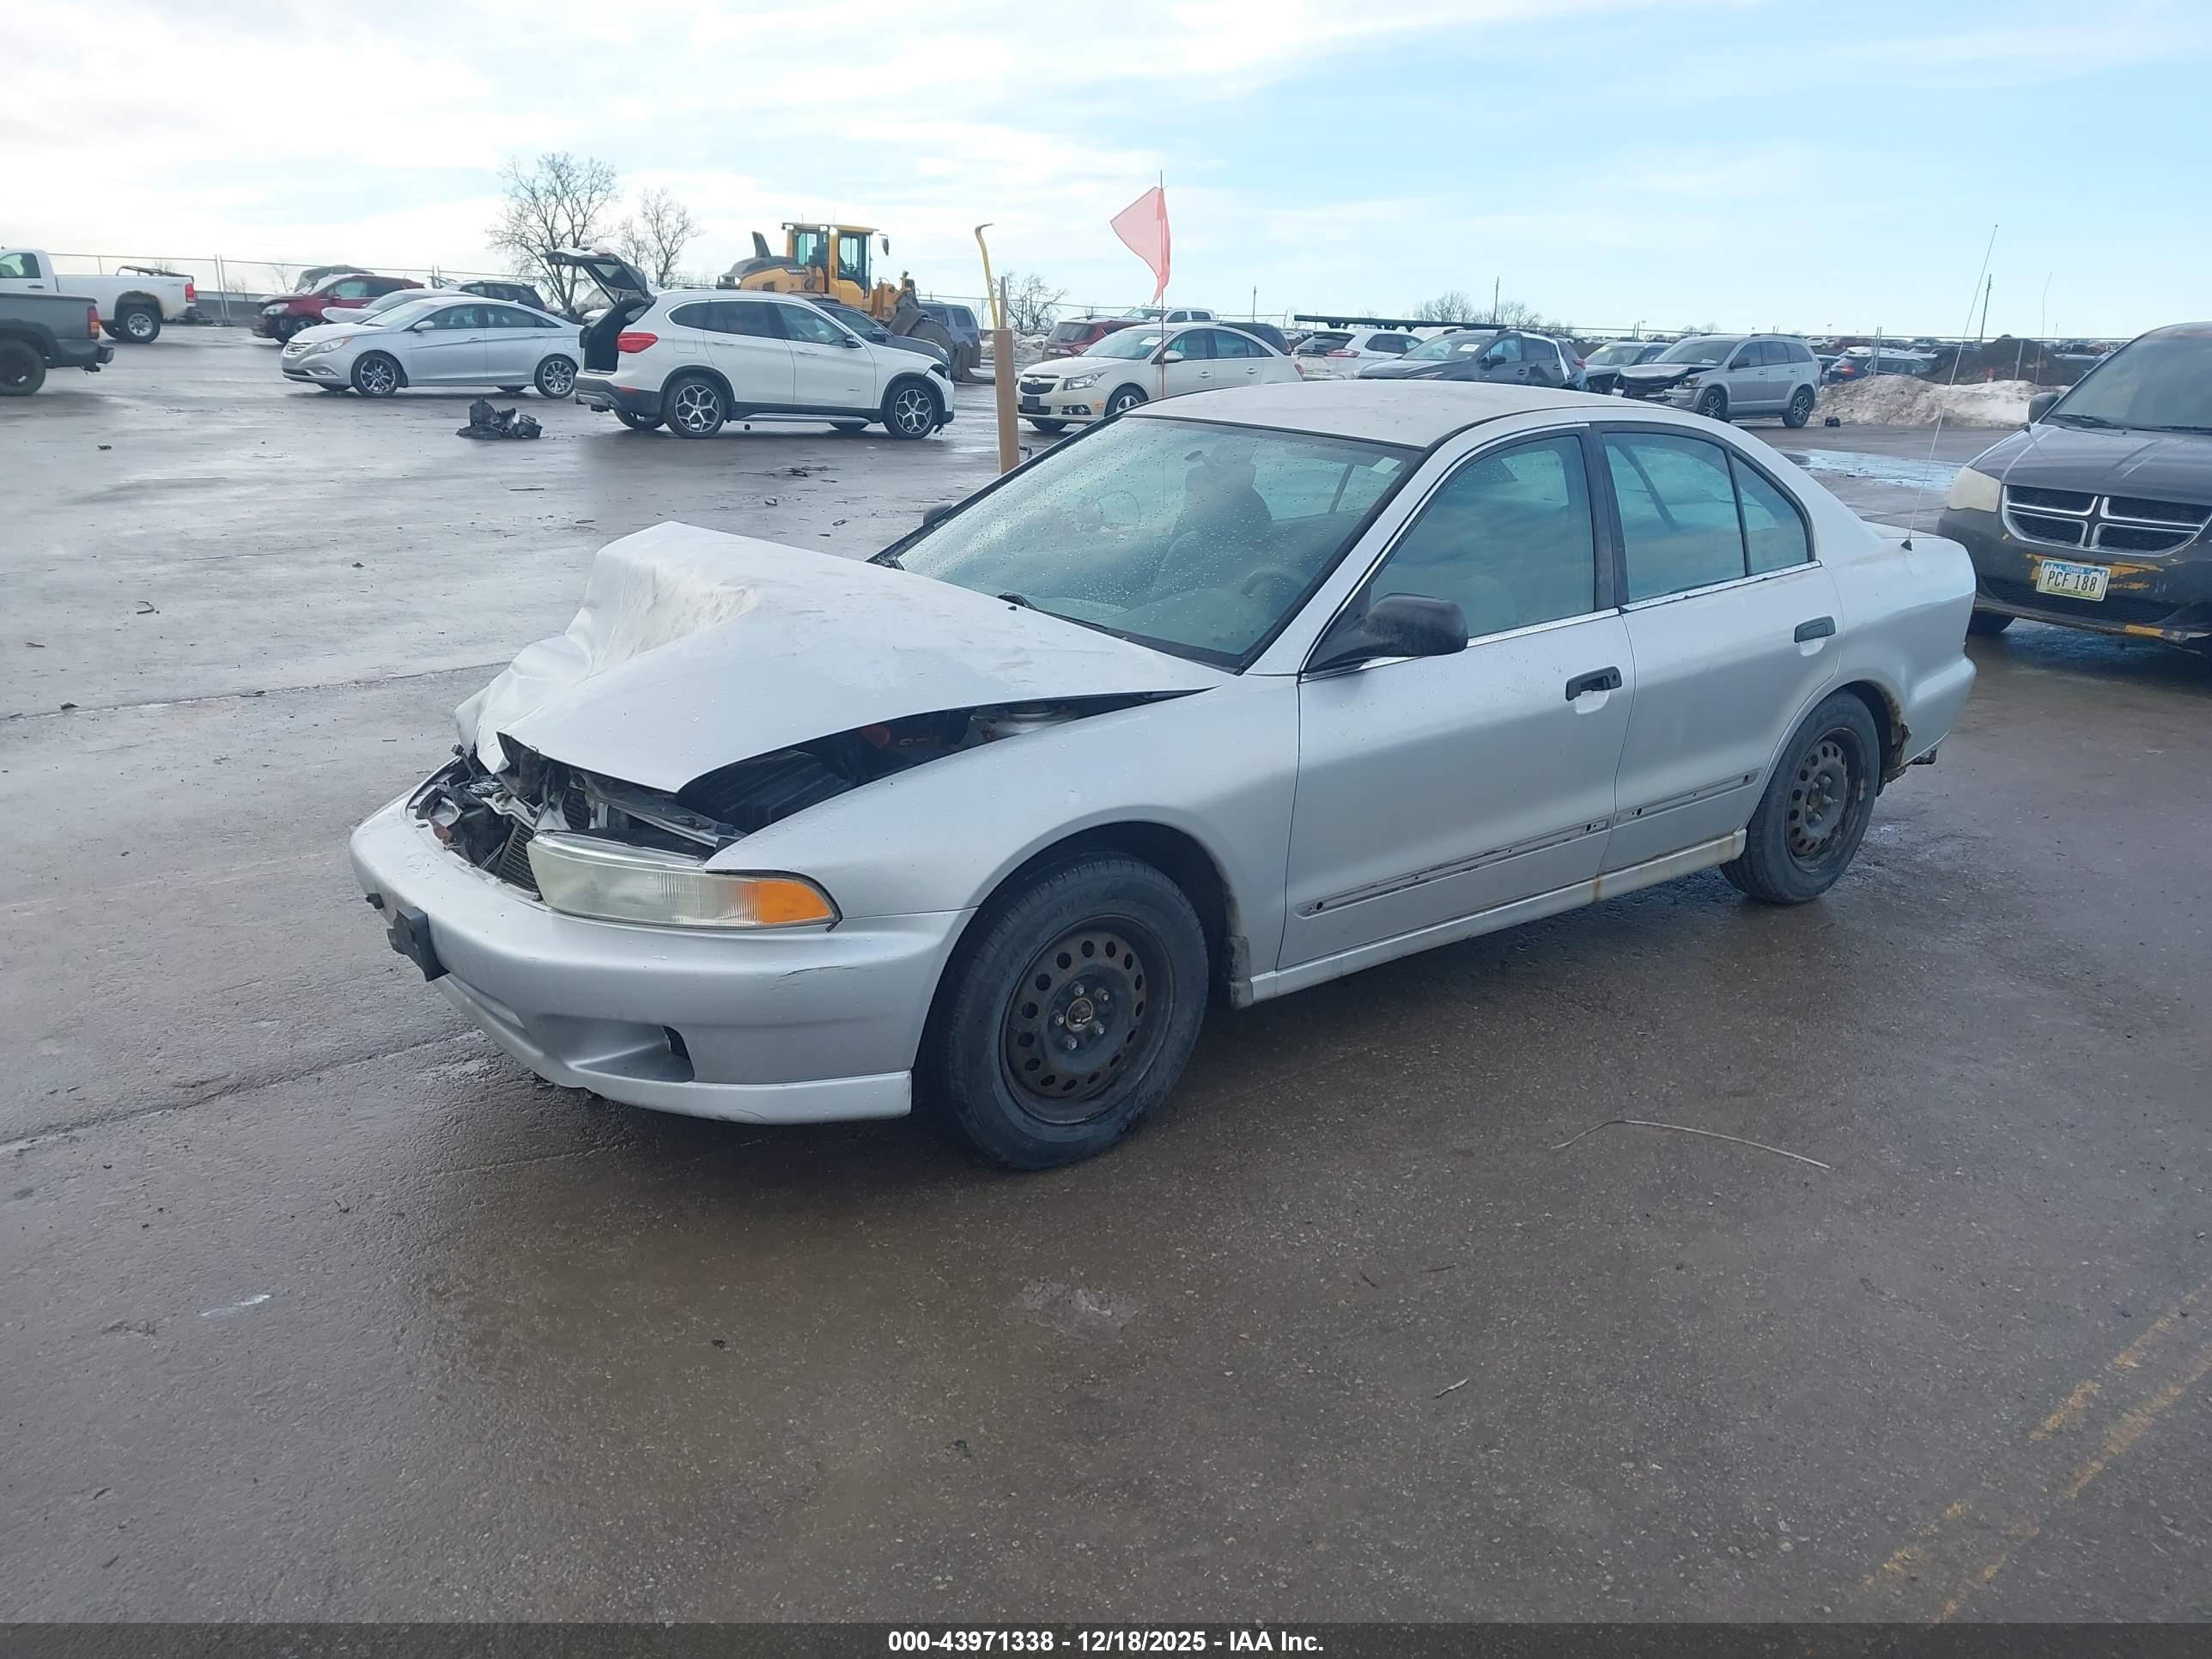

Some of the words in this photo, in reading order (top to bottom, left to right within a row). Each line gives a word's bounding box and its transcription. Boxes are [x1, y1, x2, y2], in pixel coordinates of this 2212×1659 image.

[2065, 566, 2085, 574] IOWA
[2046, 570, 2072, 587] PCF
[2074, 574, 2098, 592] 188
